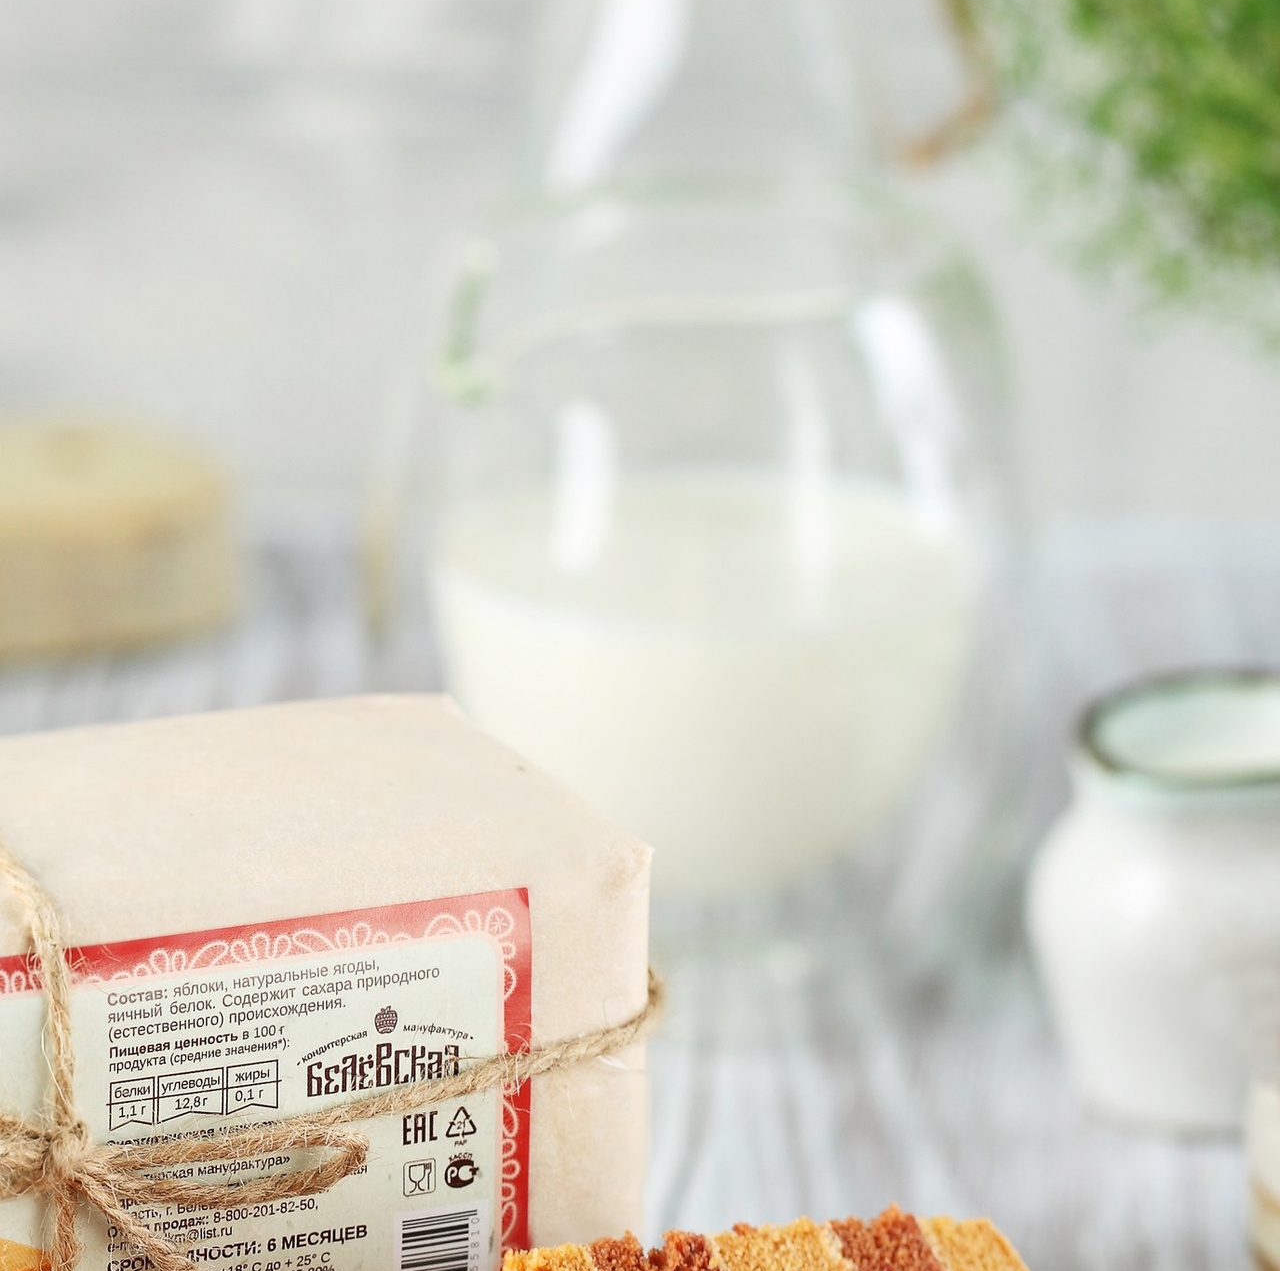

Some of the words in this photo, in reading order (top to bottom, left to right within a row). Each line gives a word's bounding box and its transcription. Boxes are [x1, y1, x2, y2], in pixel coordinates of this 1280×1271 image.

[107, 988, 168, 1006] Состав:
[173, 981, 228, 997] яблоки,
[233, 966, 329, 989] натуральные
[333, 960, 380, 976] ягоды,
[108, 1004, 163, 1023] яичный
[170, 998, 216, 1015] белок.
[222, 987, 296, 1008] Содержит
[302, 981, 353, 998] сахара
[356, 967, 440, 991] природного
[108, 1012, 225, 1042] (естественного)
[229, 998, 346, 1025] происхождения.
[109, 1040, 171, 1059] Пищевая
[174, 1031, 238, 1050] ценность
[242, 1031, 250, 1040] в
[254, 1024, 276, 1039] 100
[301, 1030, 368, 1064] кондитерская
[109, 1055, 166, 1074] продукта
[170, 1047, 221, 1066] (средние
[114, 1085, 151, 1099] белки
[161, 1075, 220, 1096] углеводы
[235, 1068, 270, 1083] жиры
[118, 1106, 138, 1119] 1,1
[235, 1088, 255, 1102] 0,1
[198, 1155, 290, 1178] мануфактура»
[154, 1215, 209, 1232] продаж:
[213, 1198, 319, 1224] 8-800-201-82-50,
[267, 1238, 277, 1252] 6
[282, 1225, 368, 1250] МЕСЯЦЕВ
